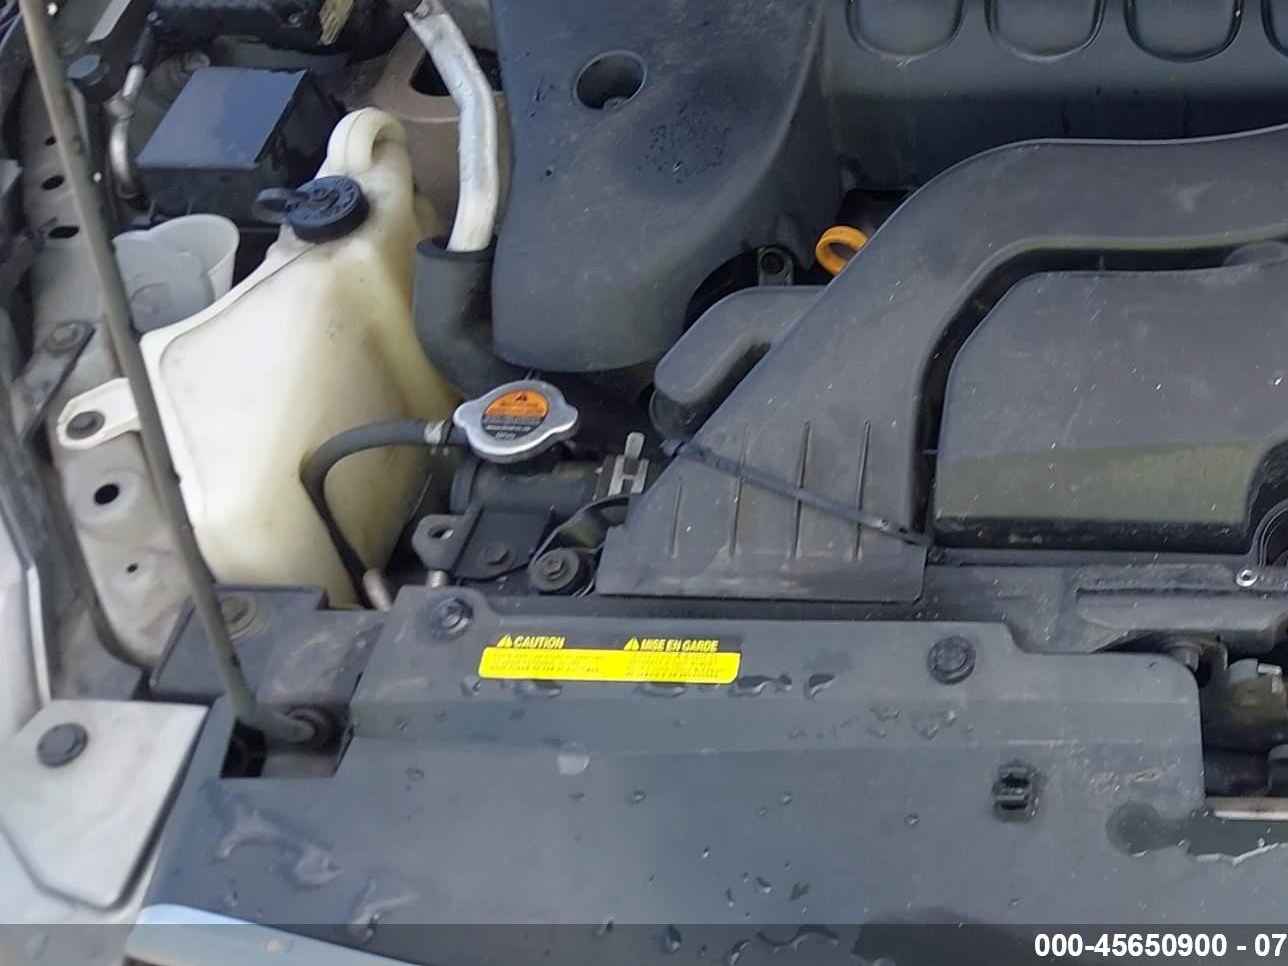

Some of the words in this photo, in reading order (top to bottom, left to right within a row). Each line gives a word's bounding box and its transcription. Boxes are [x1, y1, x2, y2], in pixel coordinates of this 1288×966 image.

[513, 635, 566, 649] CAUTION
[640, 638, 666, 651] MISE
[666, 638, 682, 652] EN
[682, 639, 719, 652] GARDE
